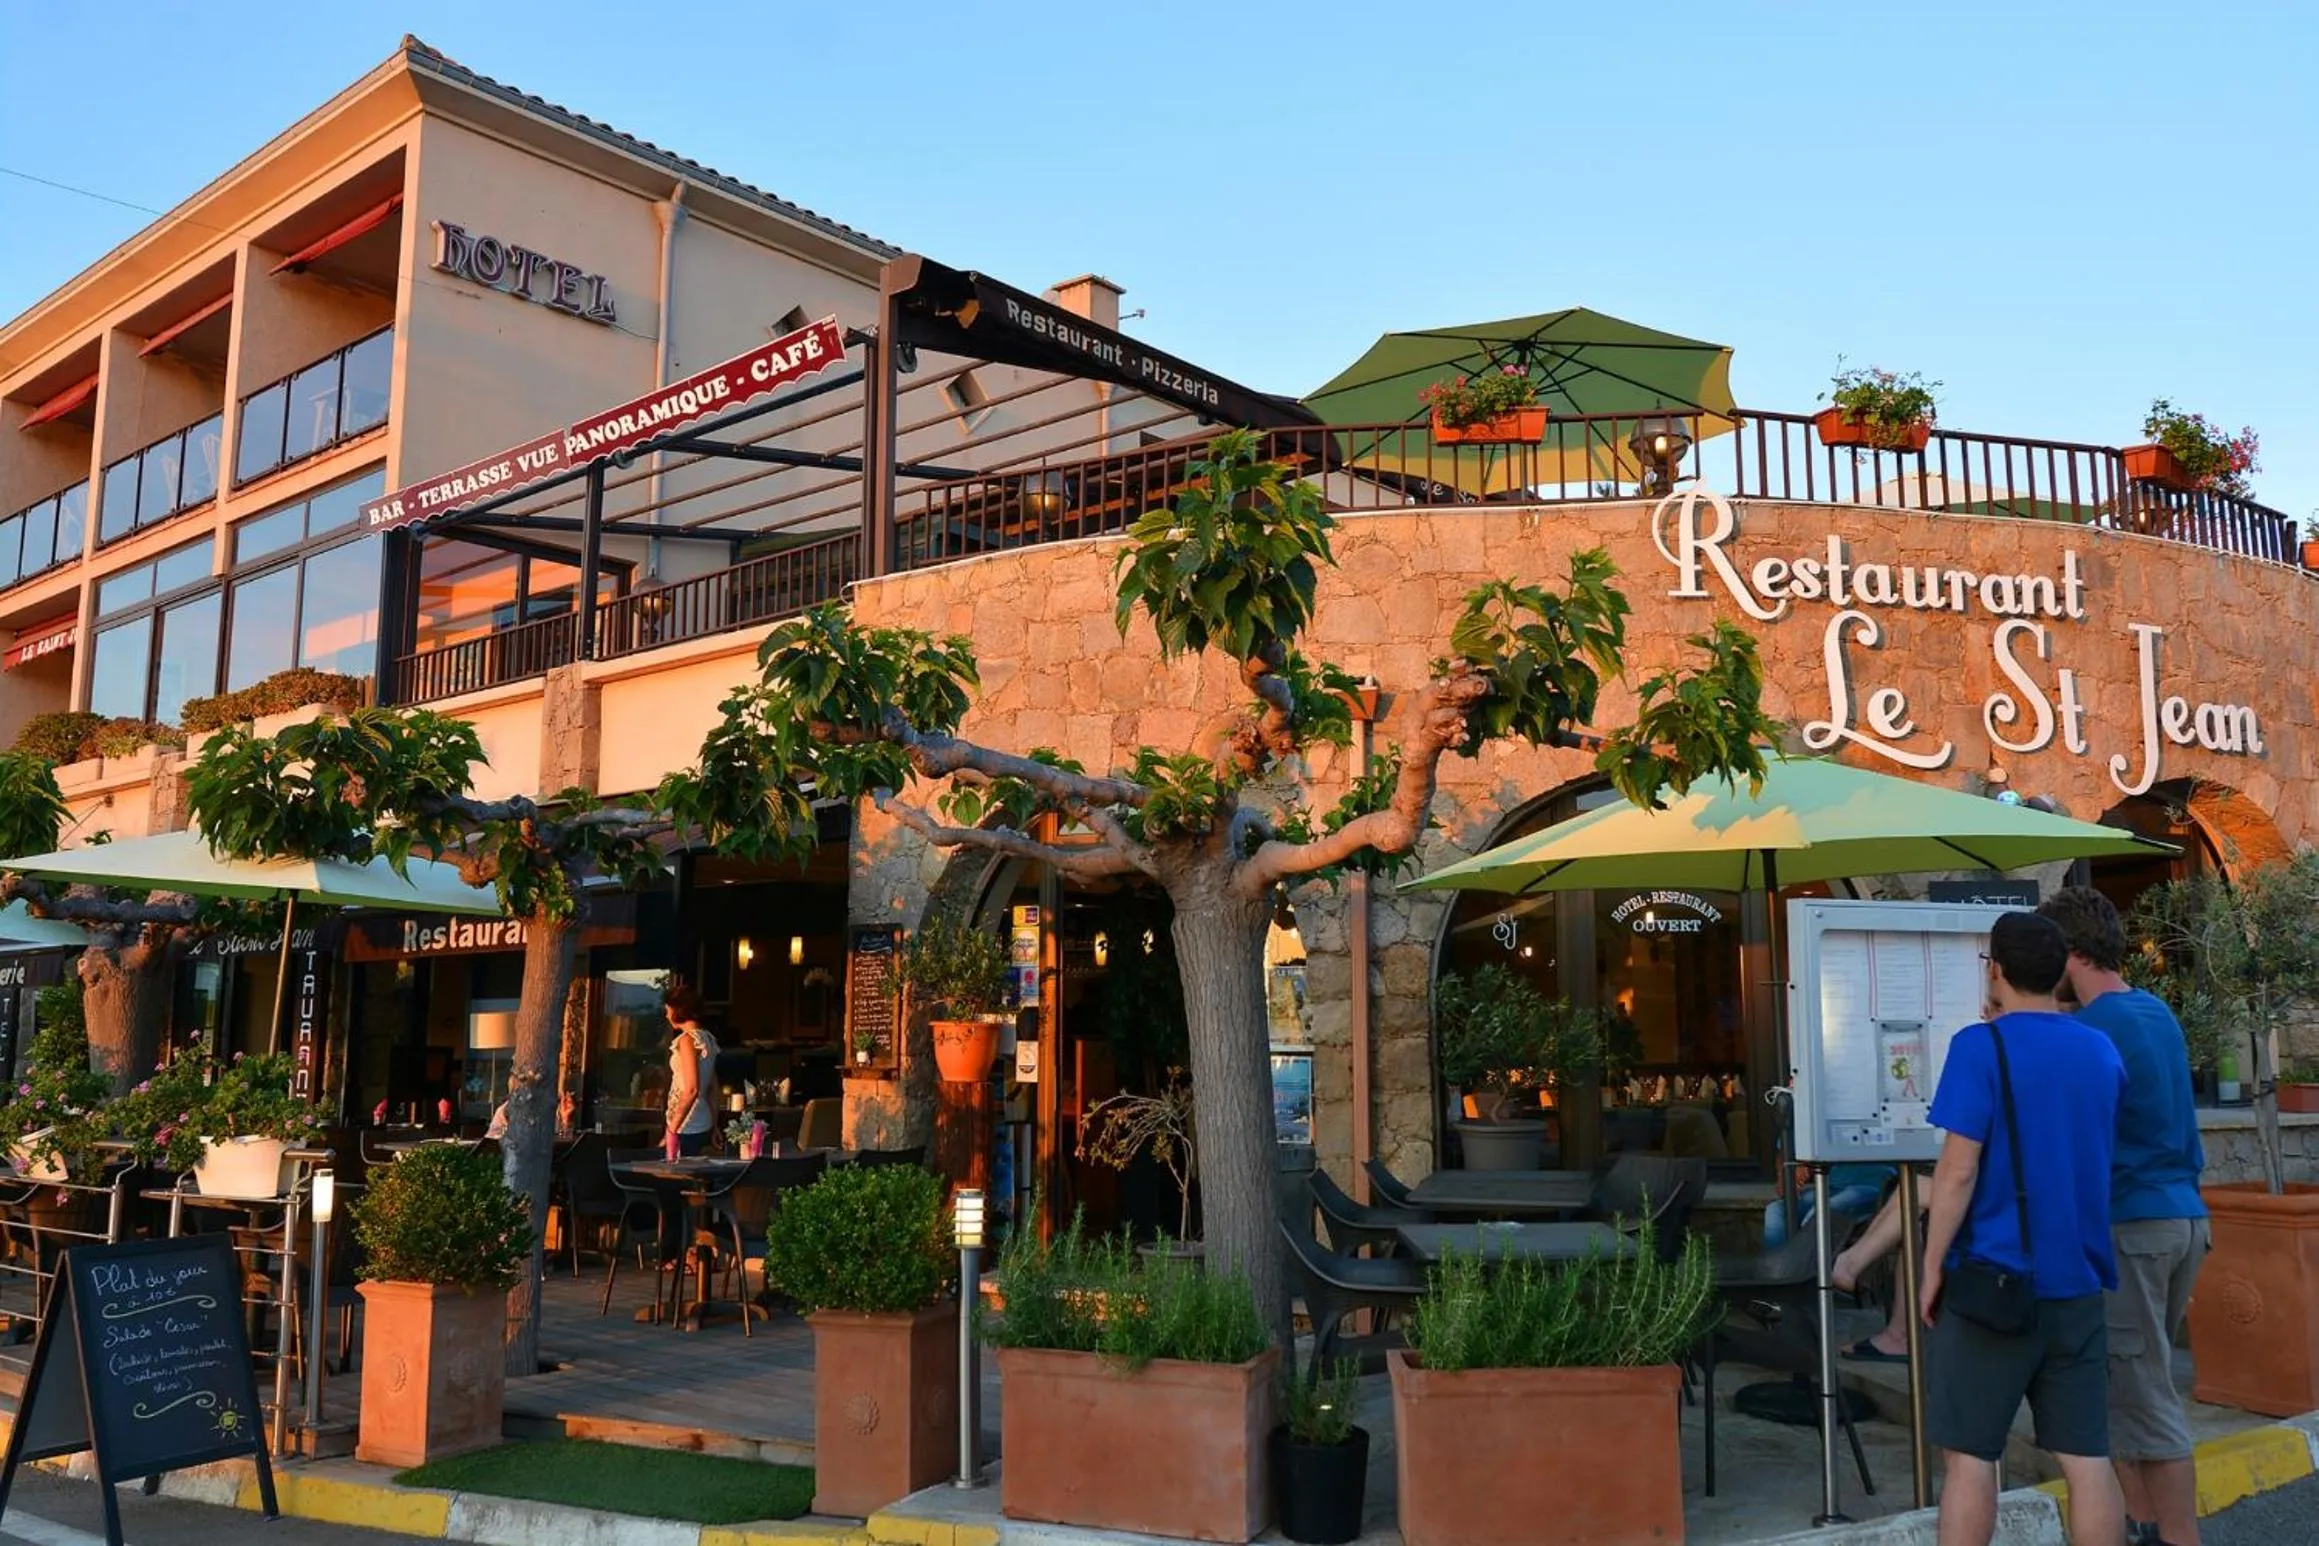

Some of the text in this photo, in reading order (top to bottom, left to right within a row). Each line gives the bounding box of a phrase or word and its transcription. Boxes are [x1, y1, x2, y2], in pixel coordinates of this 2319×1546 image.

[1006, 298, 1219, 406] Restaurant Pizzeria
[368, 330, 823, 526] BAR TERRASSE VUE PANORAMIQUE CAFÉ
[1652, 481, 2085, 621] Restaurant
[1803, 610, 2263, 796] Le St Jean
[1611, 890, 1722, 923] HOTEL RESTAURANT
[1632, 918, 1702, 933] OUVERT
[91, 1263, 140, 1297] Plat
